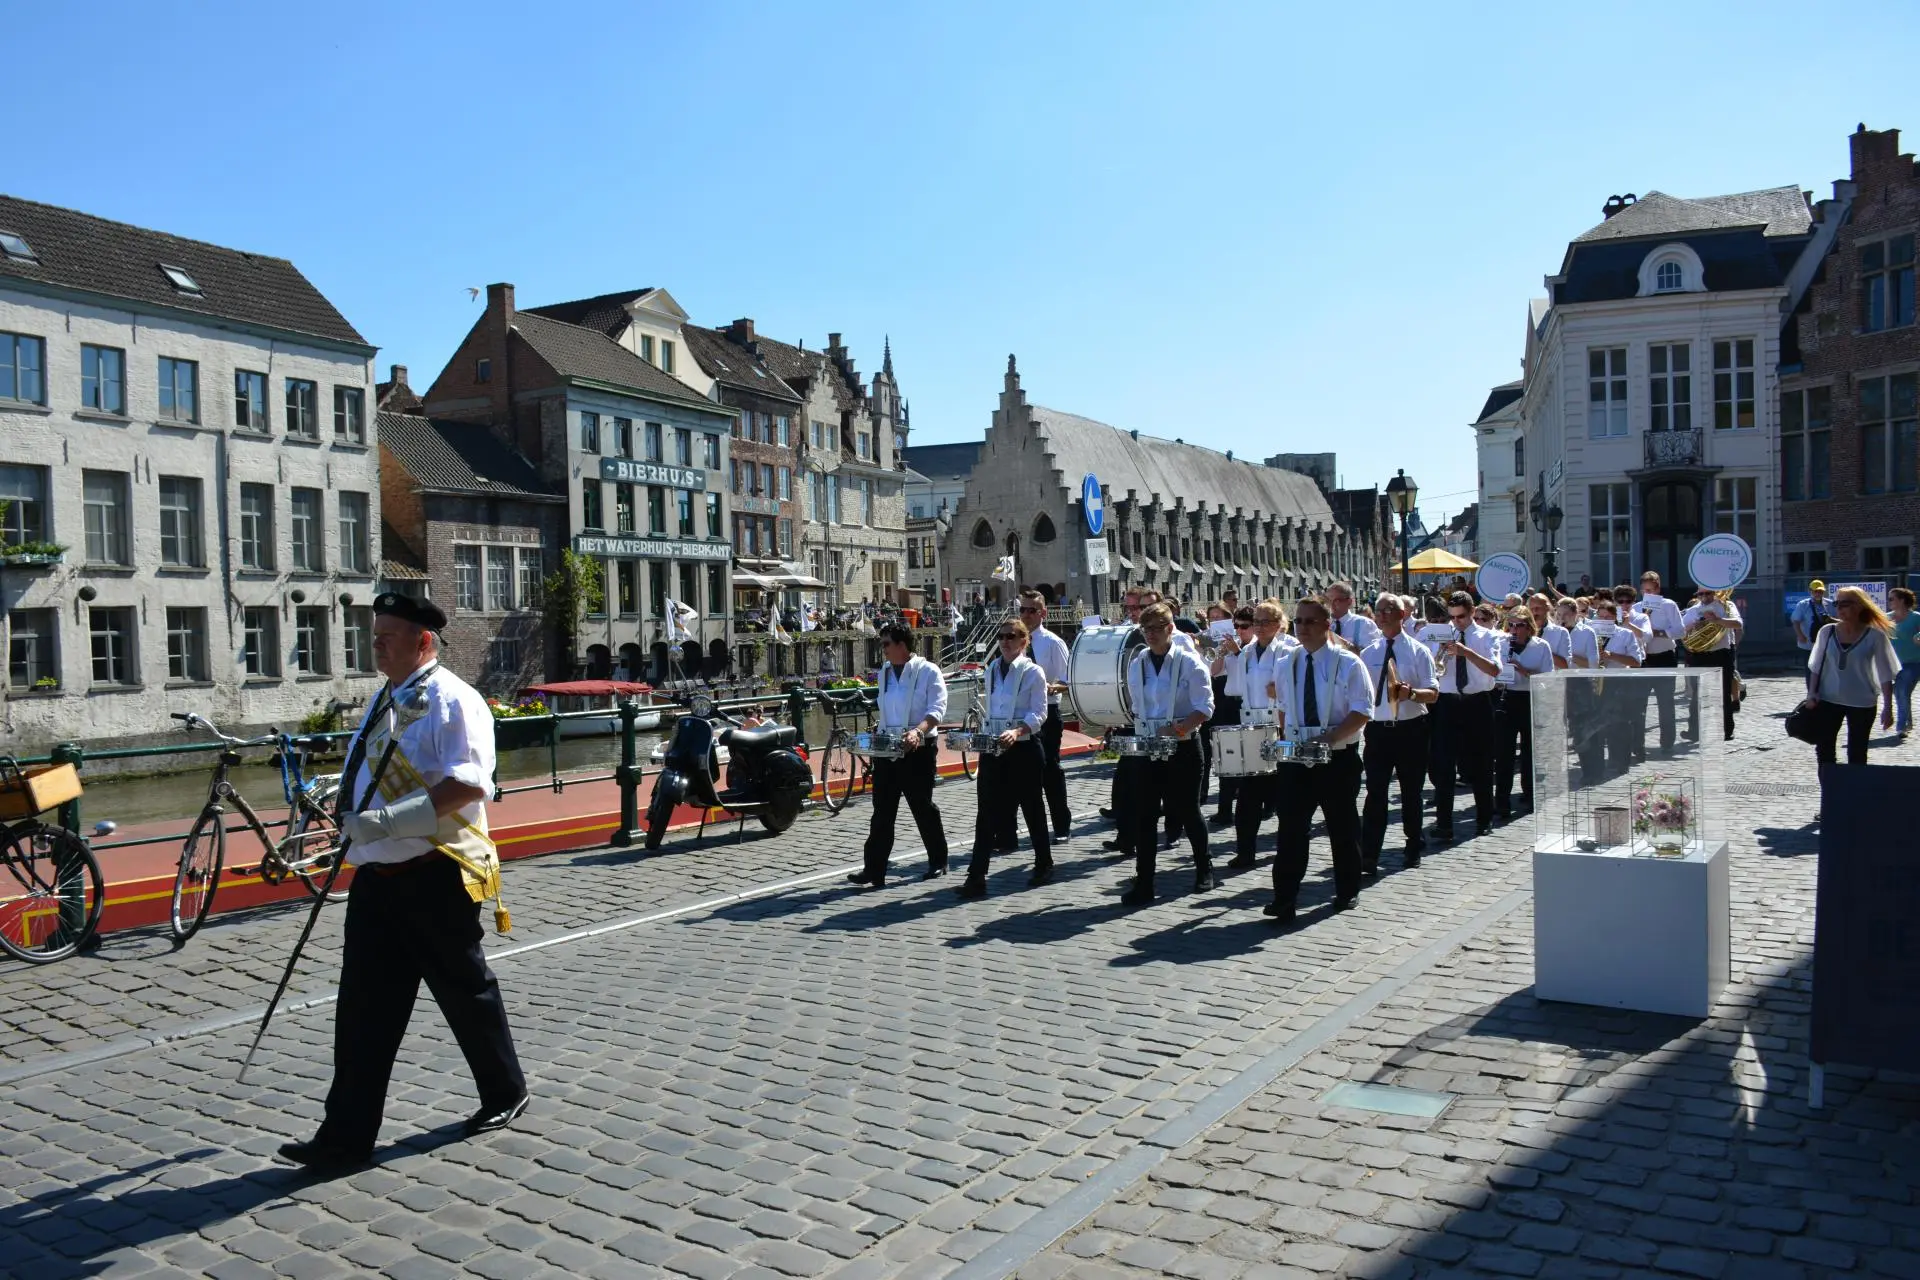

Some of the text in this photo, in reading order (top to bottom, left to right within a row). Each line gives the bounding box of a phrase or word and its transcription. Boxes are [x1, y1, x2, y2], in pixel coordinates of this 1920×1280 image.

[617, 461, 694, 486] BIERHUIS
[578, 537, 603, 553] HET
[605, 539, 673, 555] WATERHUIS
[682, 543, 730, 558] BIERKANT
[1698, 547, 1741, 556] AMICITIA
